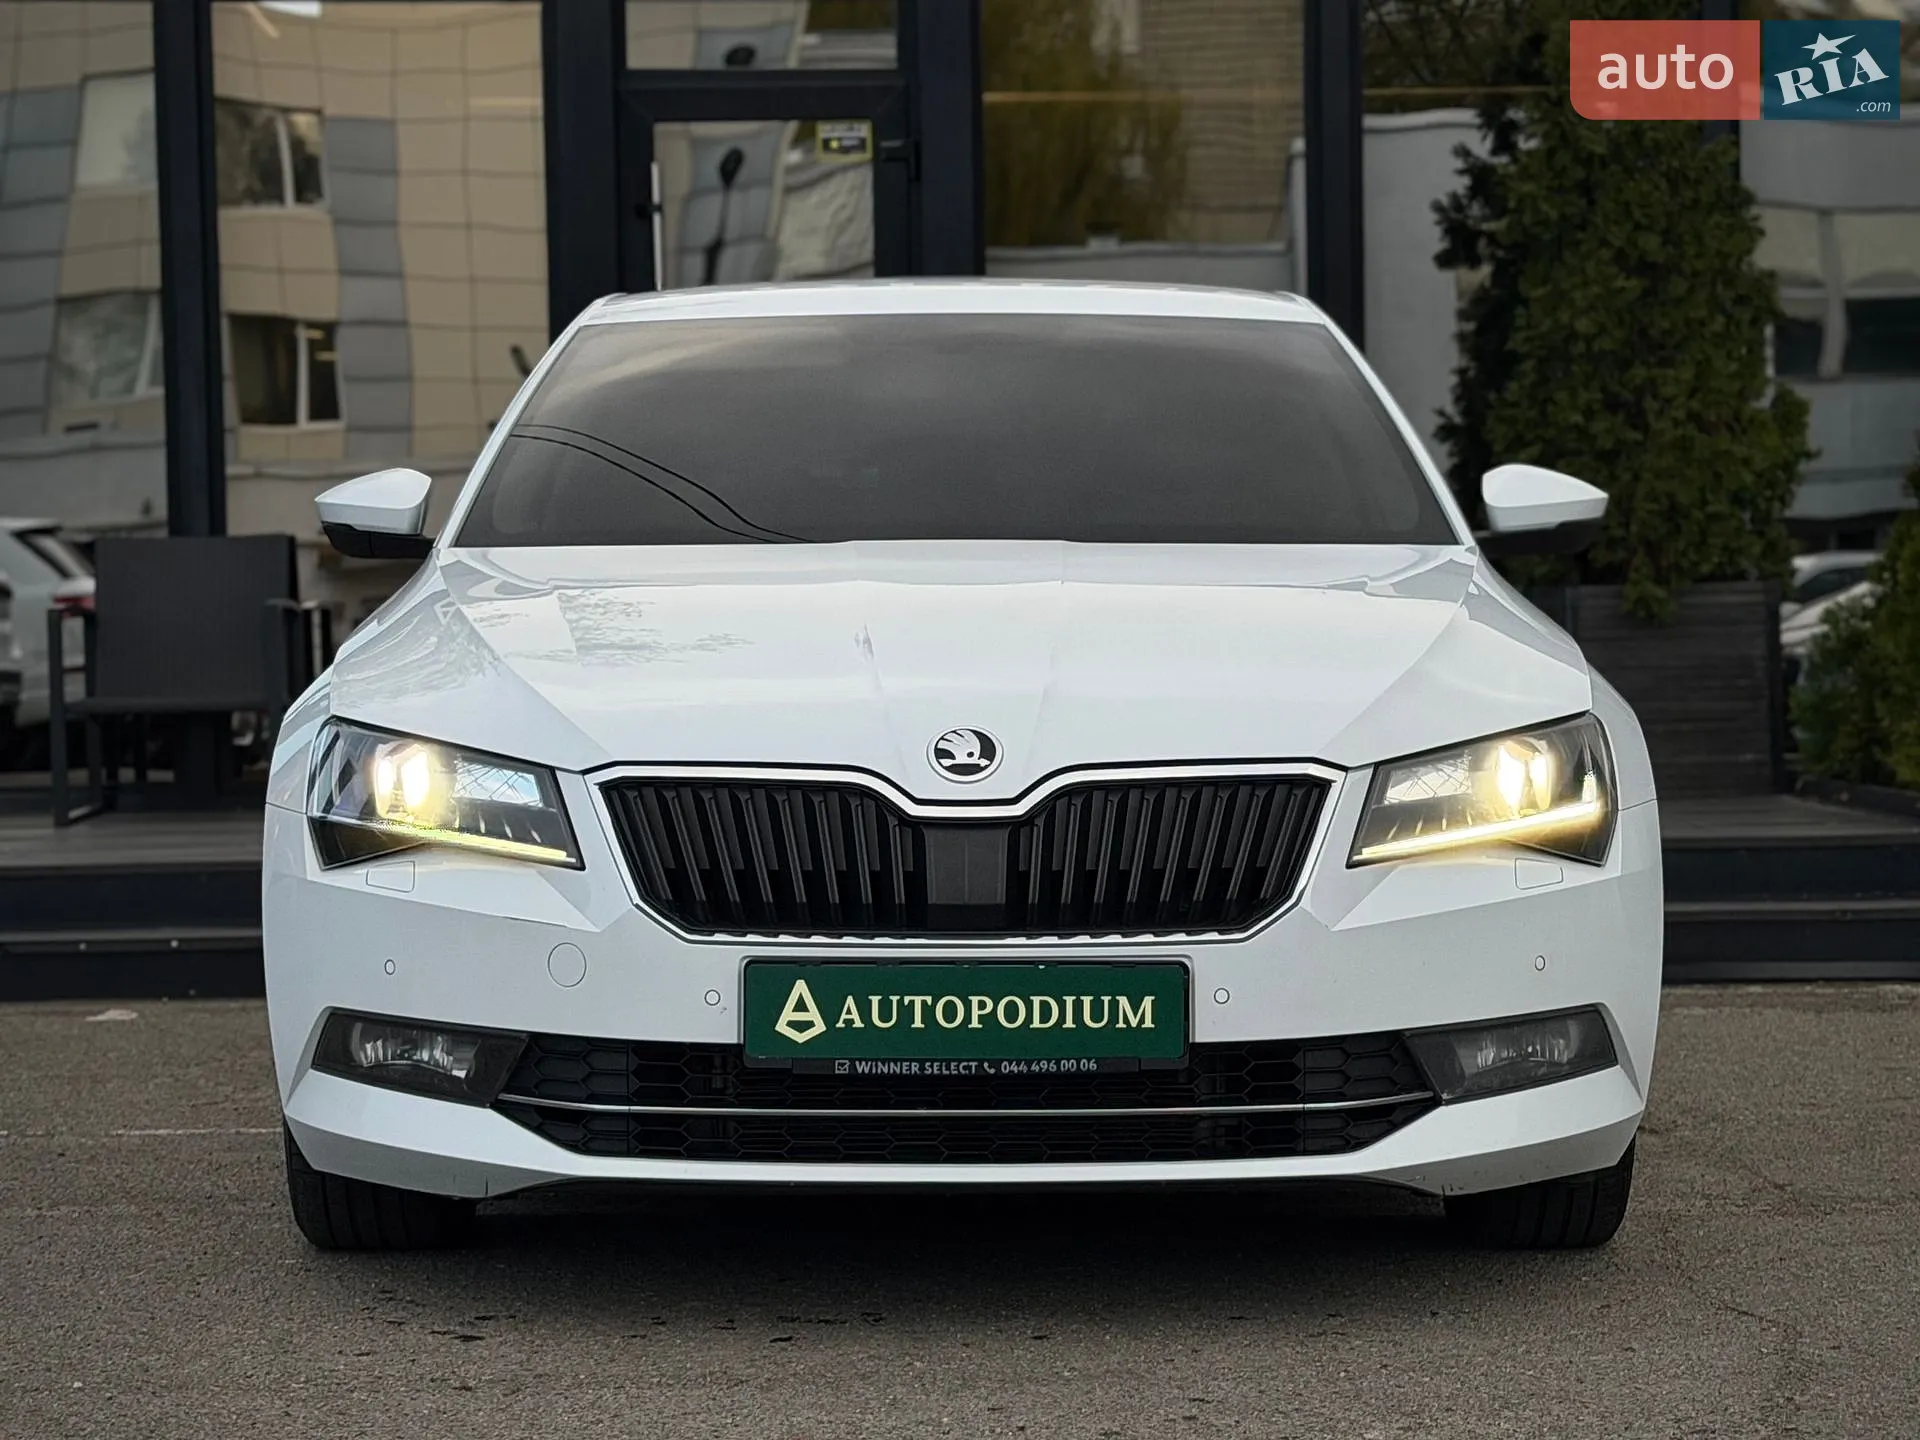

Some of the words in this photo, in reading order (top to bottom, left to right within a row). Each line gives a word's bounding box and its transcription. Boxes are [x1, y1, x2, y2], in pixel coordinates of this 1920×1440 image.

[835, 995, 1156, 1029] AUTOPODIUM
[855, 1060, 920, 1075] WINNER
[924, 1060, 979, 1075] SELECT
[1000, 1060, 1028, 1074] 044
[1030, 1060, 1057, 1073] 496
[1060, 1059, 1077, 1072] 00
[1080, 1058, 1098, 1072] 06
